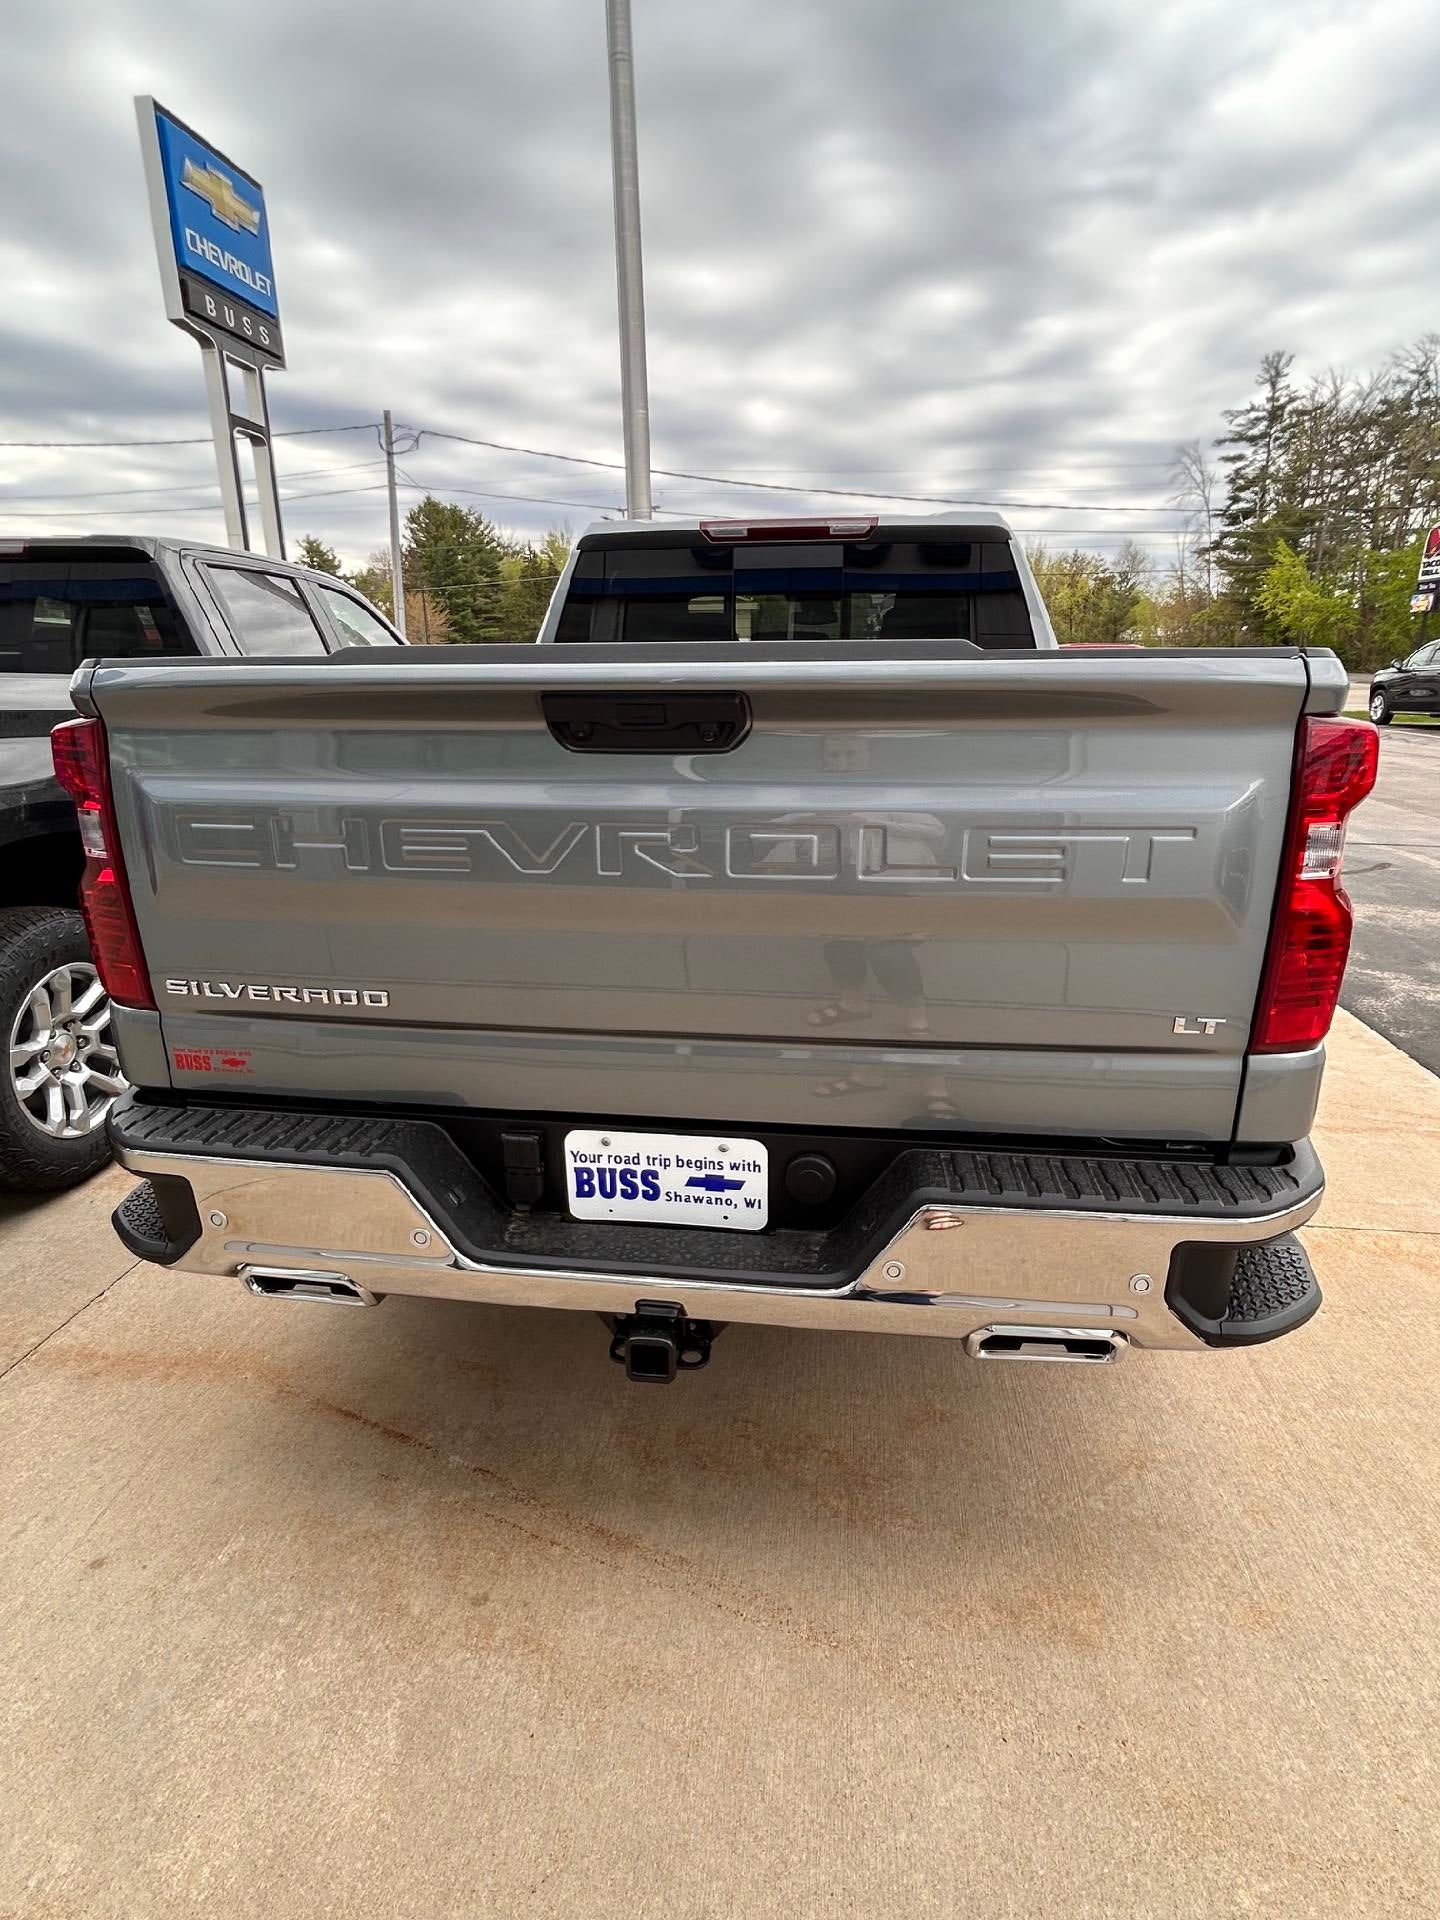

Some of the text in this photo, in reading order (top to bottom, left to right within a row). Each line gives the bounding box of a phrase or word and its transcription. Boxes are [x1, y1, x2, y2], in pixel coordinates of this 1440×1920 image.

[185, 227, 271, 296] CHEVROLET
[206, 295, 269, 344] BUSS
[175, 814, 1197, 882] CHEVROLET
[165, 979, 389, 1007] SILVERADO
[1174, 1017, 1227, 1034] LT
[175, 1053, 211, 1071] BUSS
[570, 1150, 762, 1173] Your road trip begins with
[574, 1166, 661, 1202] BUSS
[665, 1191, 762, 1210] Shawano, WI
